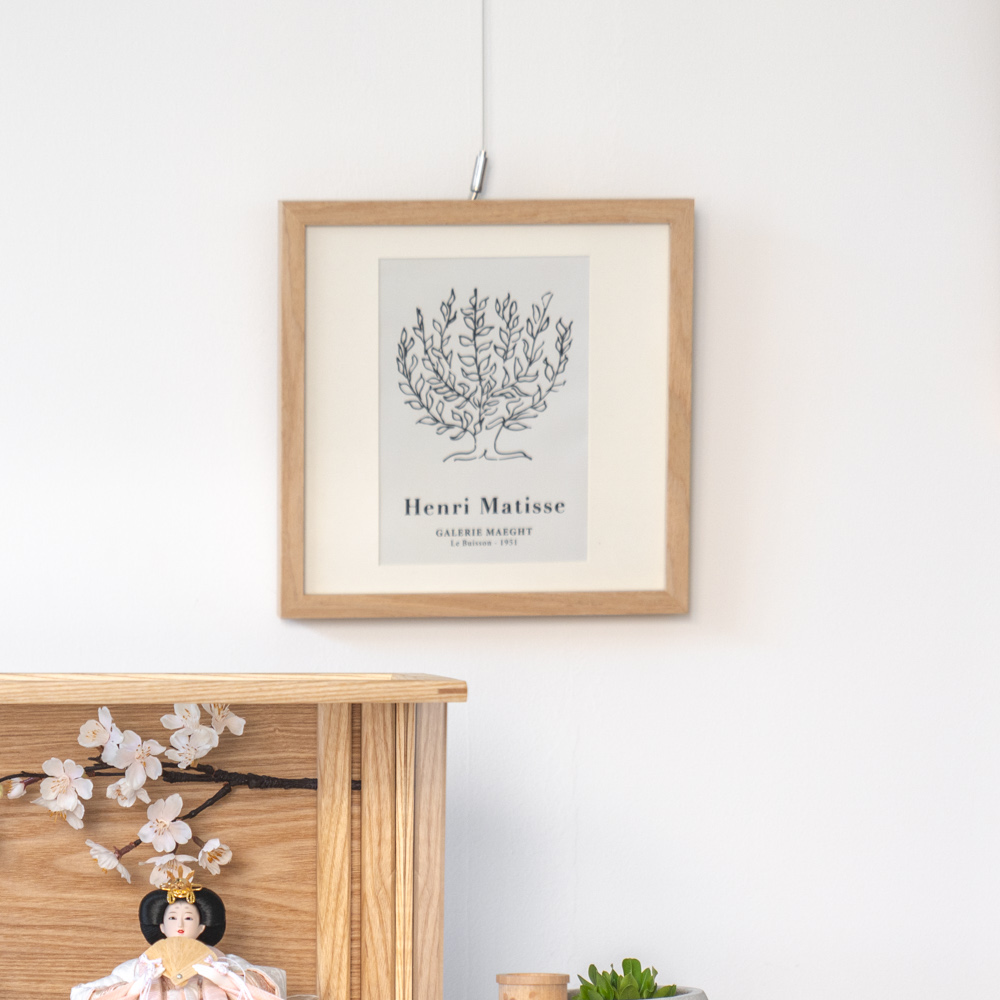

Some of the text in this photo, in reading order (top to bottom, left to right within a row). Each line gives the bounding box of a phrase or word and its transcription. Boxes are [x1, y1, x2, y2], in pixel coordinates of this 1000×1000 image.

[404, 496, 566, 515] Henri Matisse
[435, 527, 533, 537] GALERIE MAEGHT
[450, 539, 460, 547] Le
[462, 539, 492, 547] Buisson
